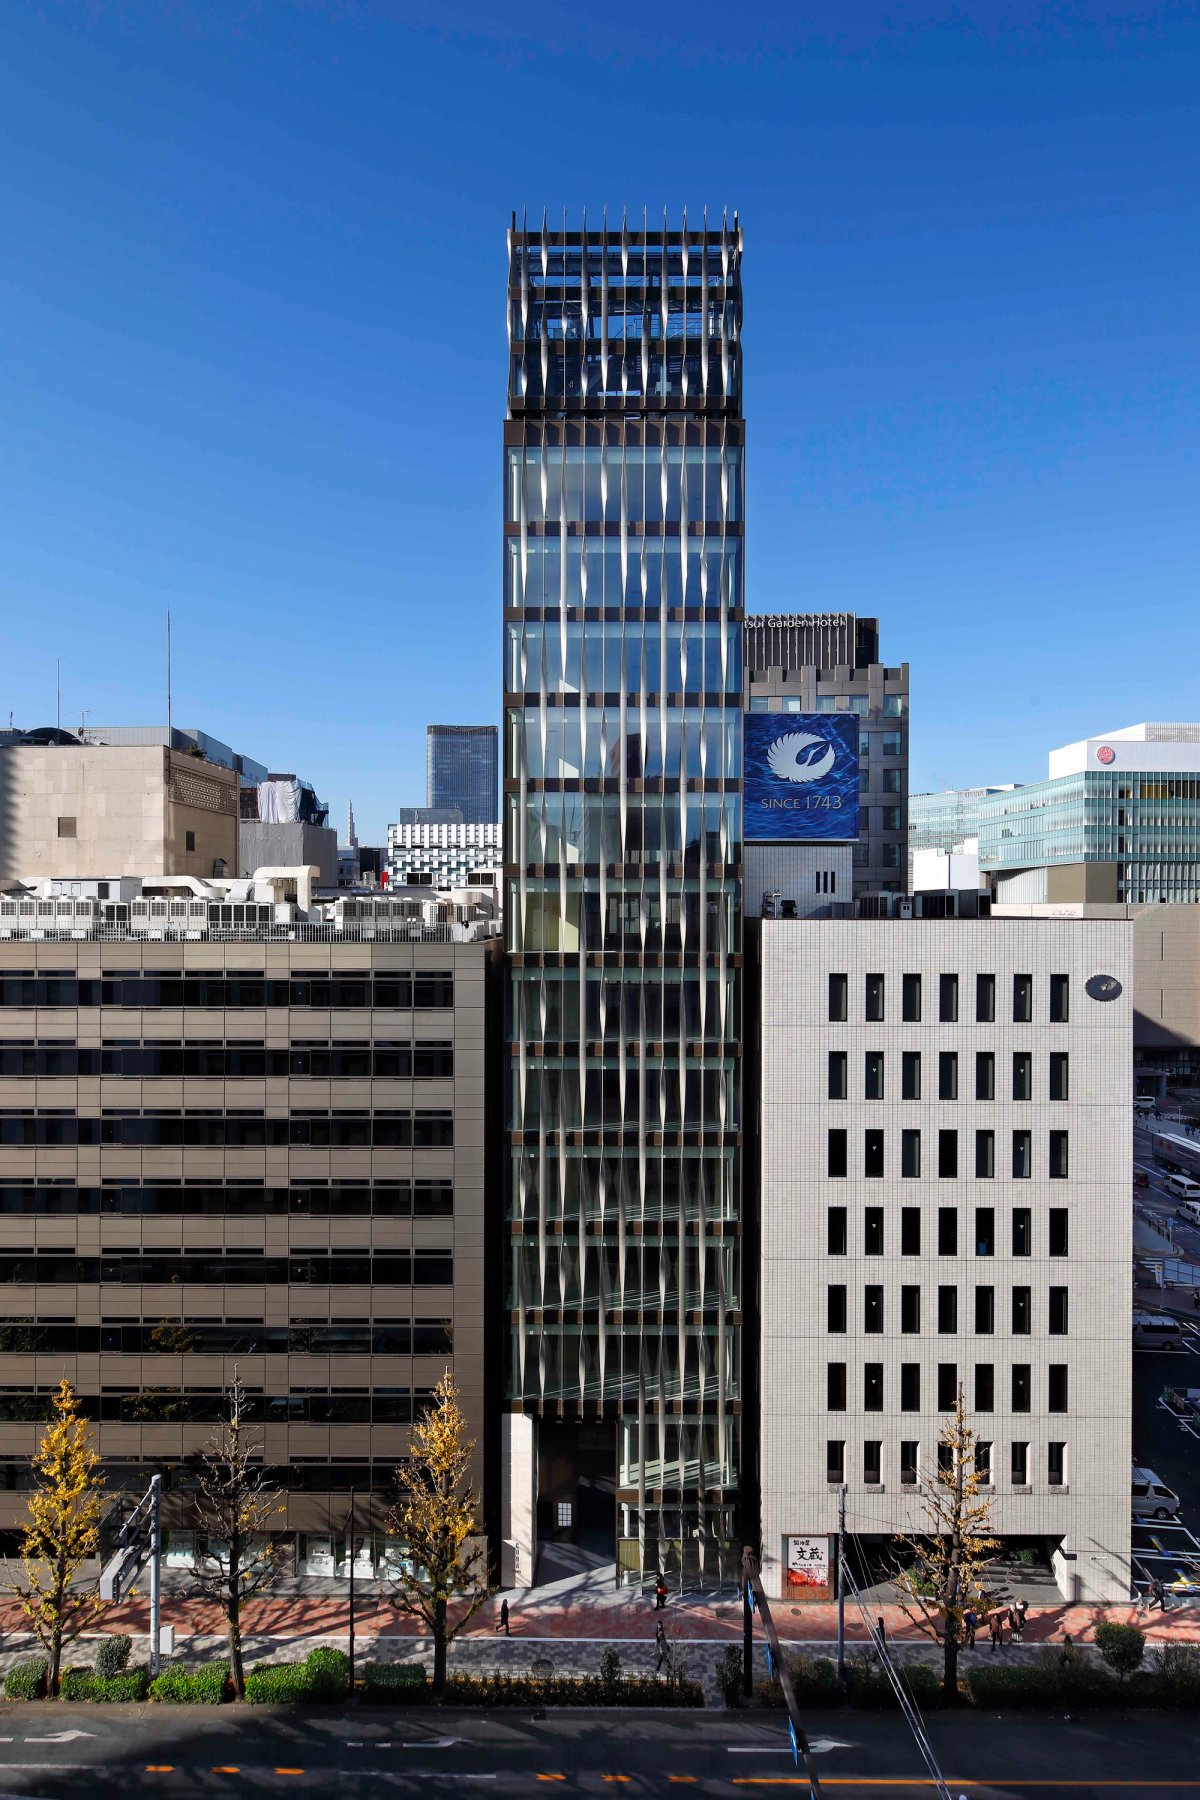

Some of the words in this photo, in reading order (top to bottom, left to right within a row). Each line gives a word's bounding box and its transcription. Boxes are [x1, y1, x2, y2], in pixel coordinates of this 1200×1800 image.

[767, 617, 808, 628] Garden
[812, 617, 843, 627] Hotel
[761, 798, 800, 809] SINCE
[805, 795, 841, 809] 1743
[796, 1546, 824, 1561] 文蔵
